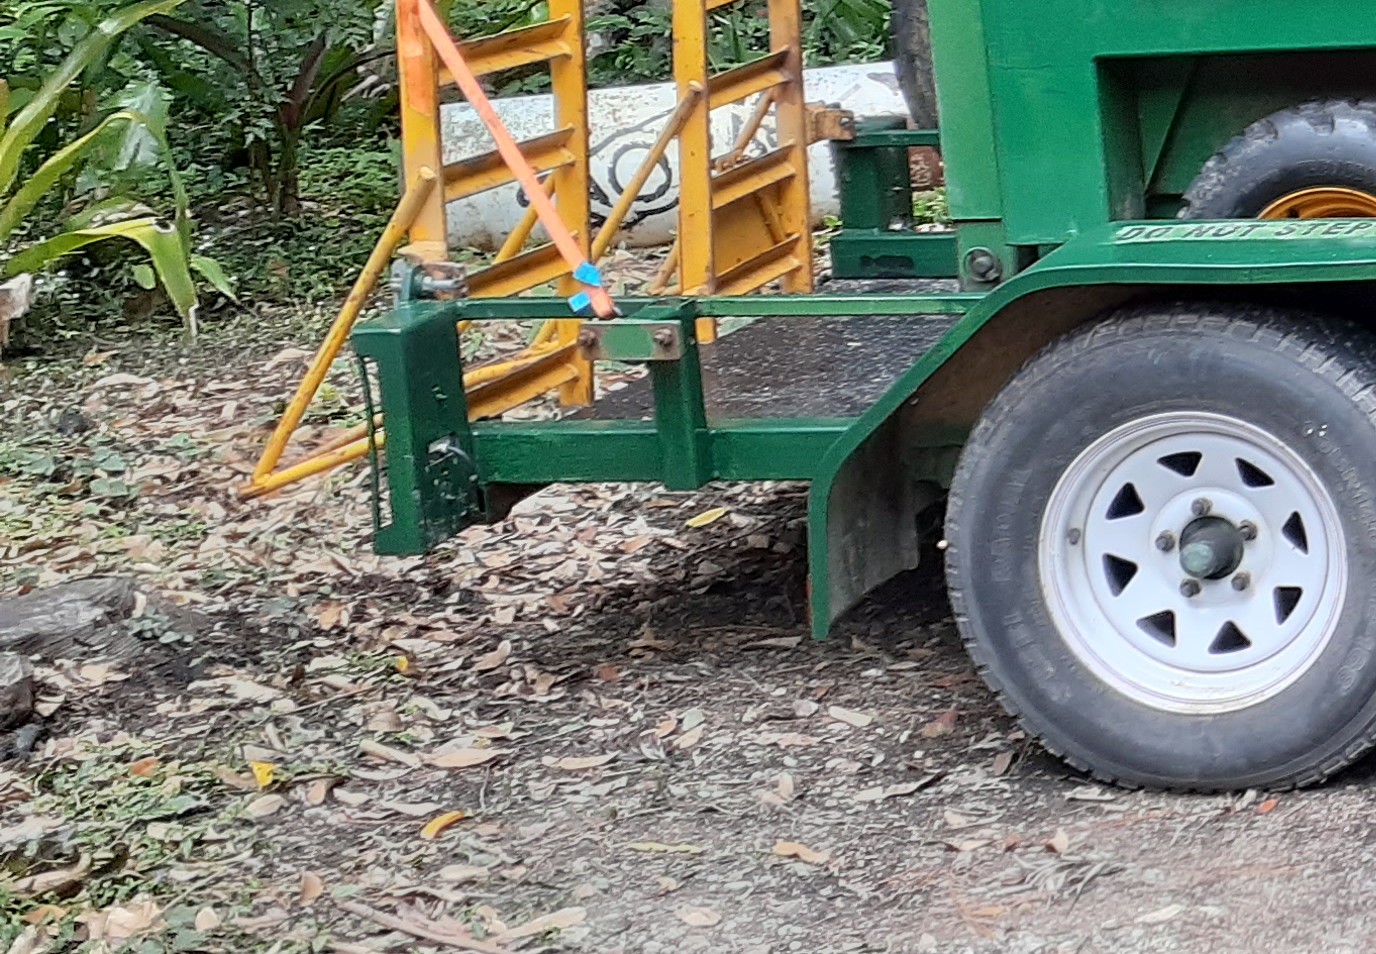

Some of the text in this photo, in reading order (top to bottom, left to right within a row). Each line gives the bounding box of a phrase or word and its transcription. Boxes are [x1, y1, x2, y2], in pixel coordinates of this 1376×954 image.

[1118, 226, 1174, 241] DO
[1182, 224, 1267, 239] NOT
[1274, 222, 1375, 237] STEP
